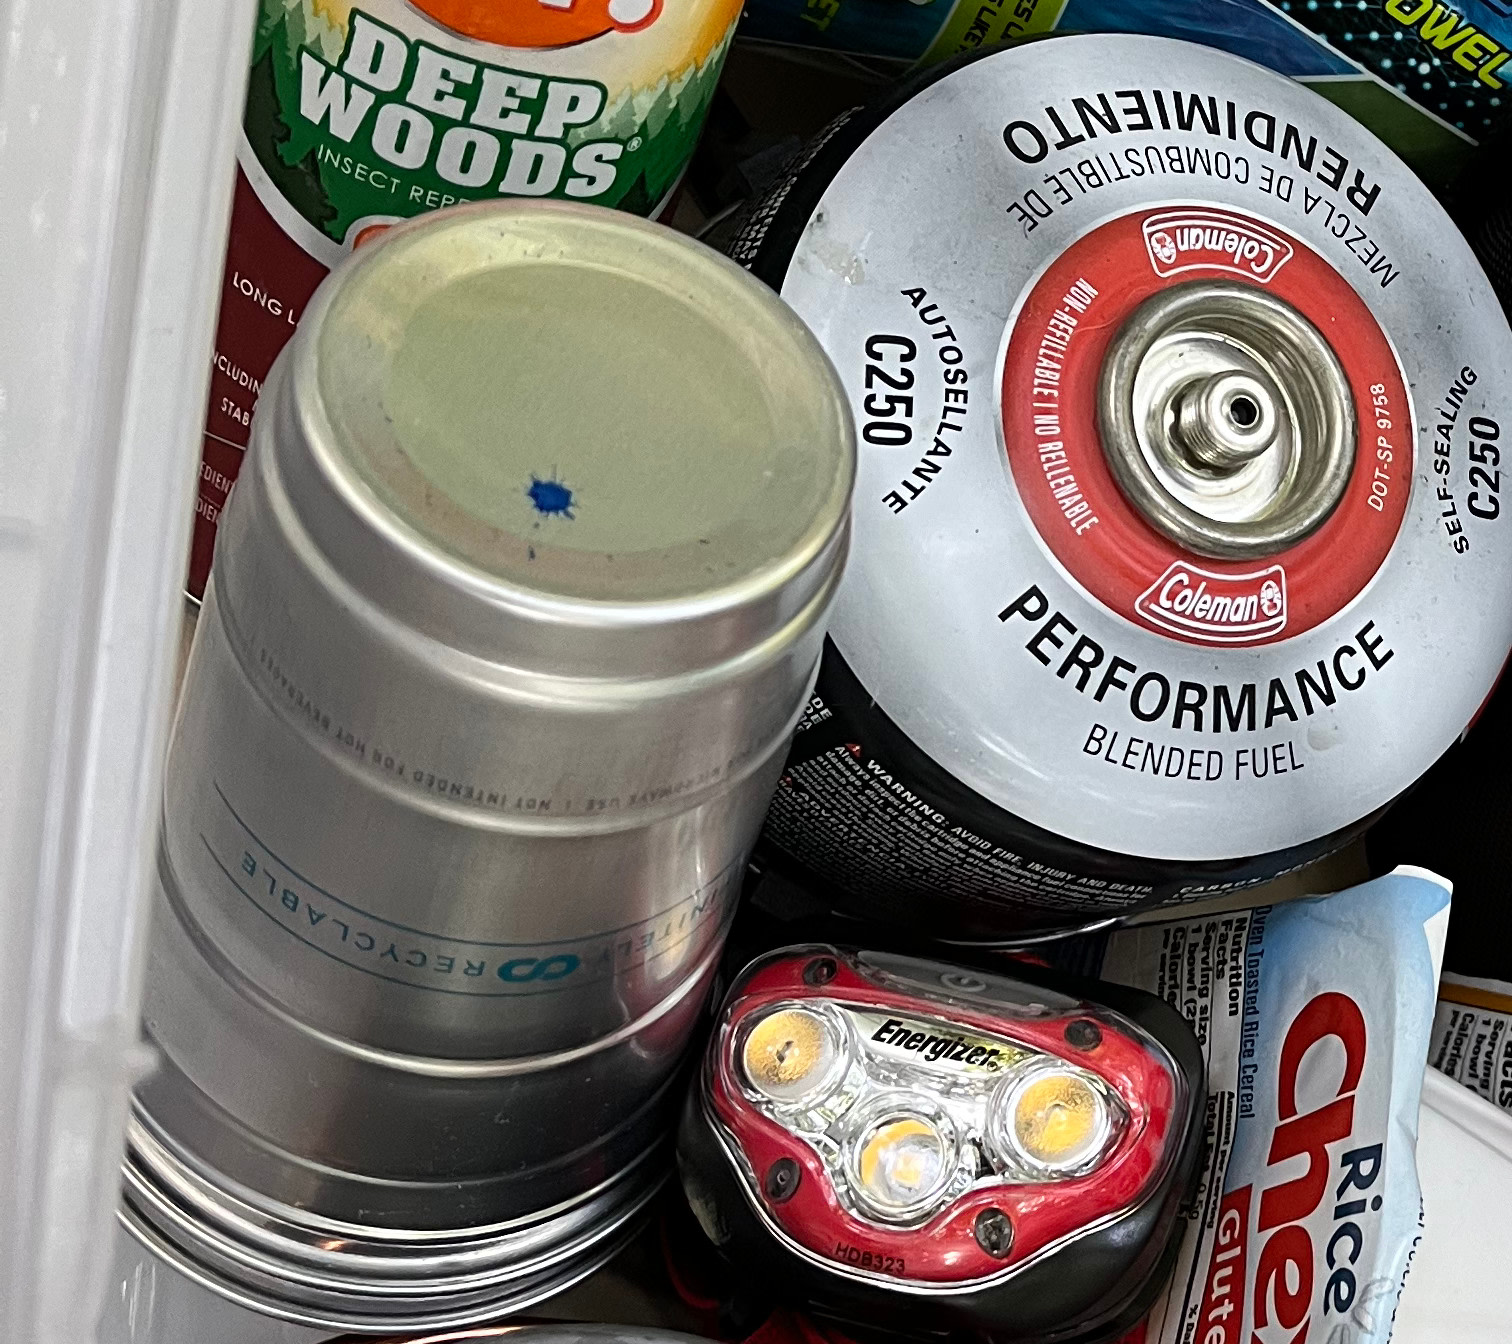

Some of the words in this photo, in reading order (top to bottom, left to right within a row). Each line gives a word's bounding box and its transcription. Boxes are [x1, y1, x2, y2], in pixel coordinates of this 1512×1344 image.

[963, 6, 997, 47] LIKE
[342, 9, 604, 141] DEEP
[299, 51, 624, 197] WOODS
[1002, 87, 1385, 217] RENDIMIENTO
[318, 143, 401, 195] INSECT
[1055, 143, 1251, 208] COMBUSTIBLE
[1259, 163, 1295, 201] DE
[1006, 189, 1054, 232] DE
[1304, 189, 1401, 289] MEZCLA
[1176, 225, 1277, 274] Coleman
[232, 271, 284, 317] LONG
[1033, 277, 1097, 398] NON-REFILLABLE
[862, 332, 918, 447] C250
[881, 284, 971, 516] AUTOSELLANTE
[1369, 382, 1393, 432] 9758
[1036, 440, 1099, 537] RELLENABLE
[1367, 435, 1393, 513] DOT-SP
[1431, 364, 1480, 556] SELF-SEALING
[1467, 415, 1501, 524] C250
[1157, 573, 1259, 623] Coleman
[999, 585, 1396, 734] PERFORMANCE
[1082, 723, 1224, 782] BLENDED
[1236, 739, 1305, 781] FUEL
[411, 768, 508, 810] INTENDED
[867, 758, 950, 828] WARNING:
[949, 826, 993, 852] AVOID
[1027, 860, 1071, 882] INJURY
[1073, 874, 1105, 890] AND
[240, 849, 486, 978] RECYCLABLE
[1249, 905, 1273, 947] Oven
[1186, 942, 1200, 993] bowl
[1198, 921, 1218, 1000] Serving
[1215, 919, 1234, 981] Facts
[1228, 916, 1249, 1017] Nutrition
[1244, 949, 1265, 1018] Toasted
[870, 1017, 999, 1066] Energizer
[1242, 1021, 1261, 1059] Rice
[1239, 1062, 1259, 1119] Cereal
[834, 1241, 907, 1275] HDB323
[1321, 1141, 1384, 1316] Rice
